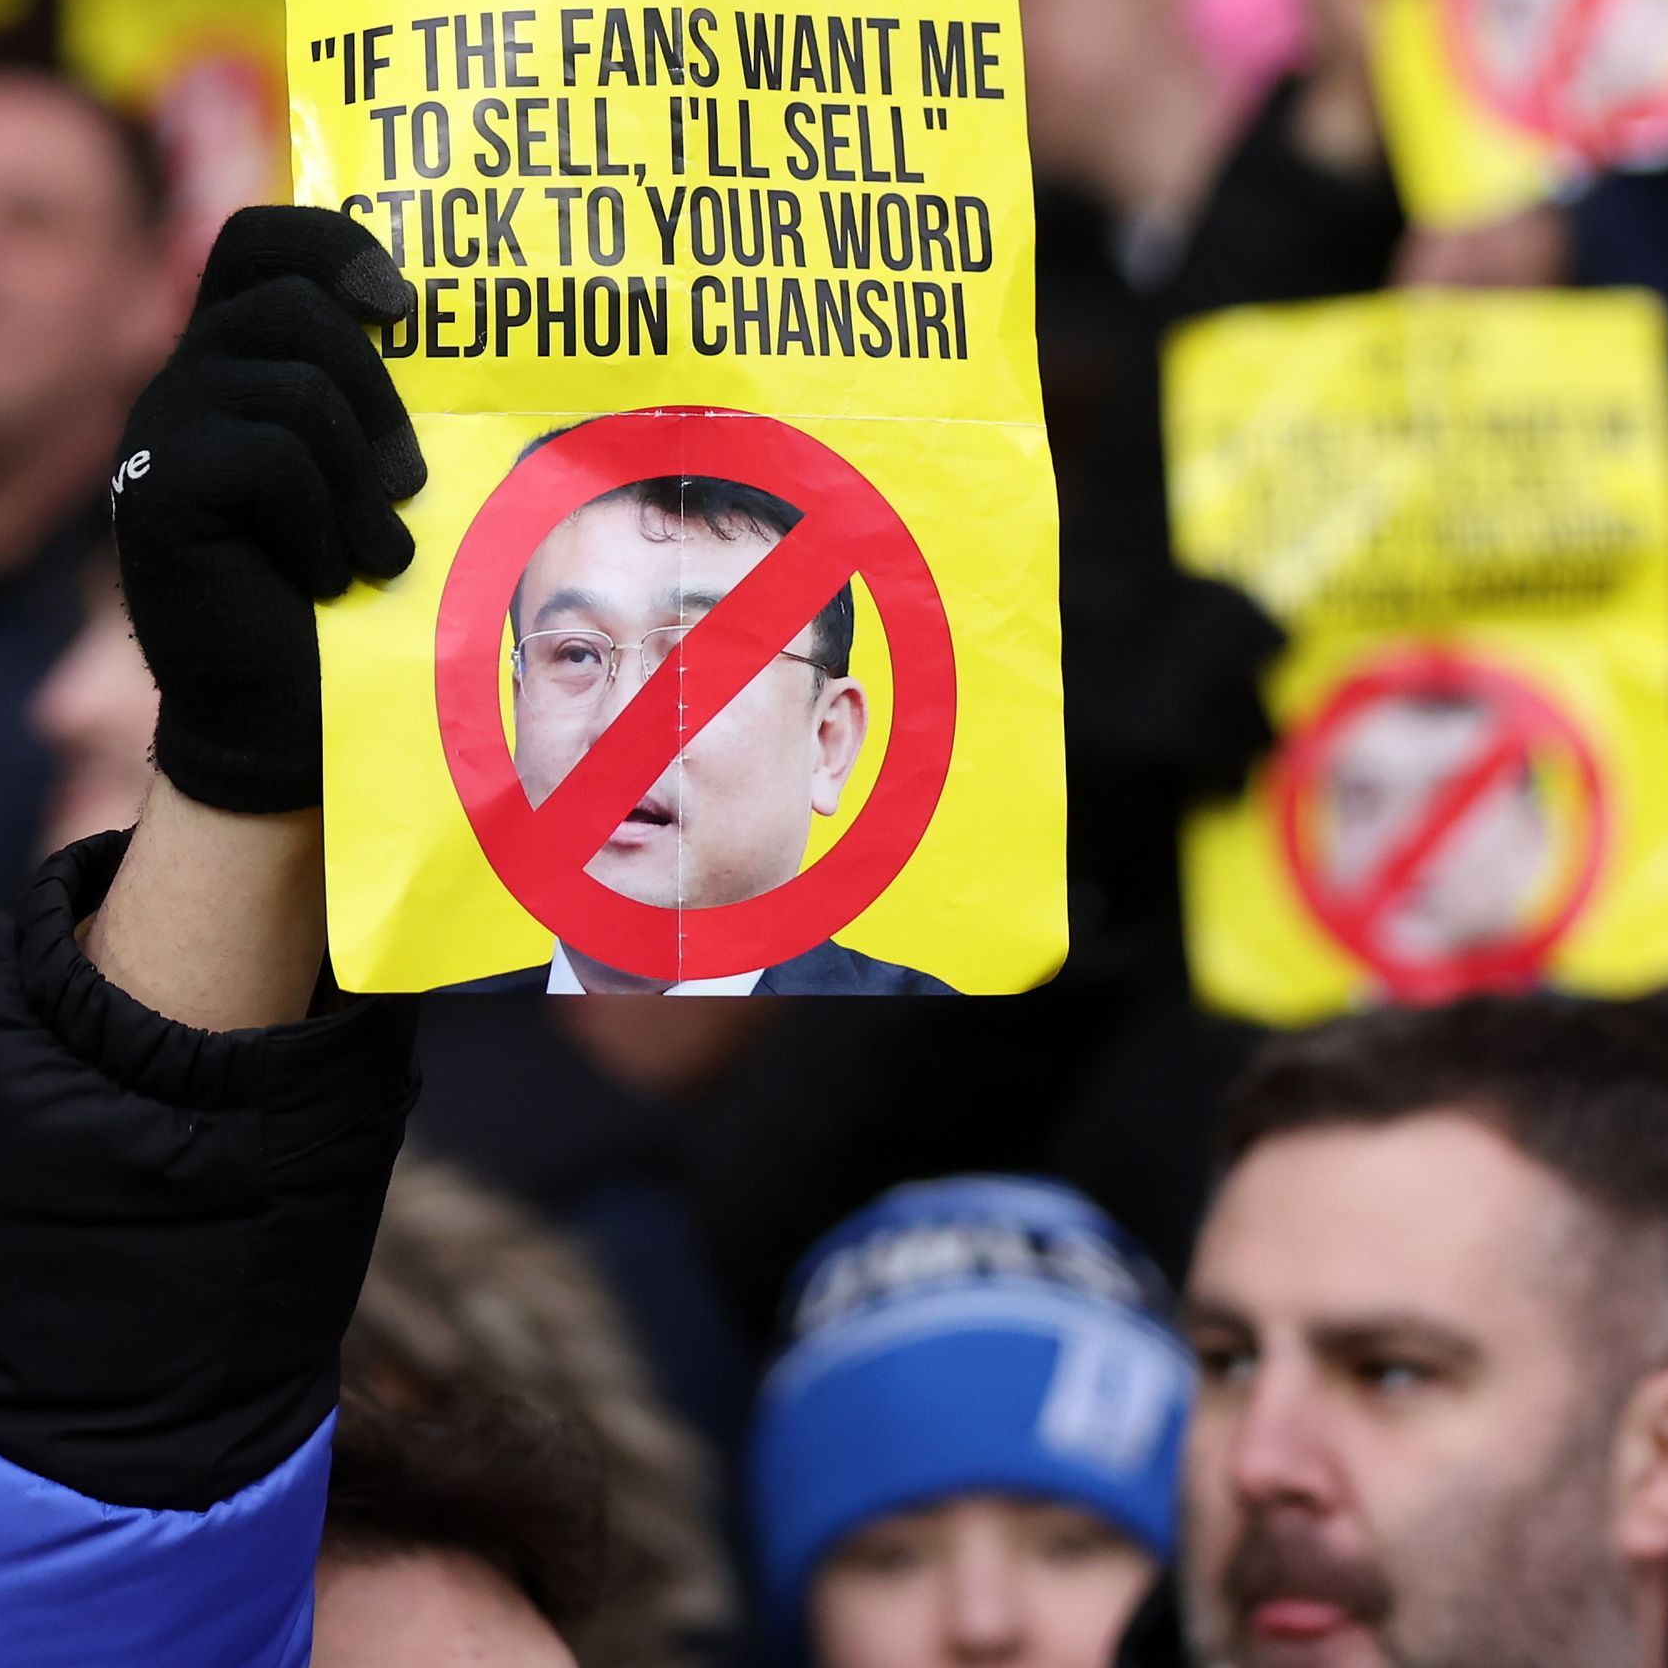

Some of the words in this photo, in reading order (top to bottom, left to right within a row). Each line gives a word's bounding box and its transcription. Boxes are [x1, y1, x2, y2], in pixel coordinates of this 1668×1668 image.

[310, 24, 394, 106] "IF
[412, 10, 540, 92] THE
[561, 7, 720, 88] FANS
[735, 10, 901, 96] WANT
[919, 19, 1005, 100] ME
[369, 101, 450, 181] TO
[473, 97, 647, 187] SELL,
[670, 96, 771, 179] I'LL
[784, 101, 948, 184] SELL"
[544, 187, 626, 267] TO
[644, 185, 807, 268] YOUR
[820, 191, 993, 273] WORD
[691, 274, 968, 360] CHANSIRI
